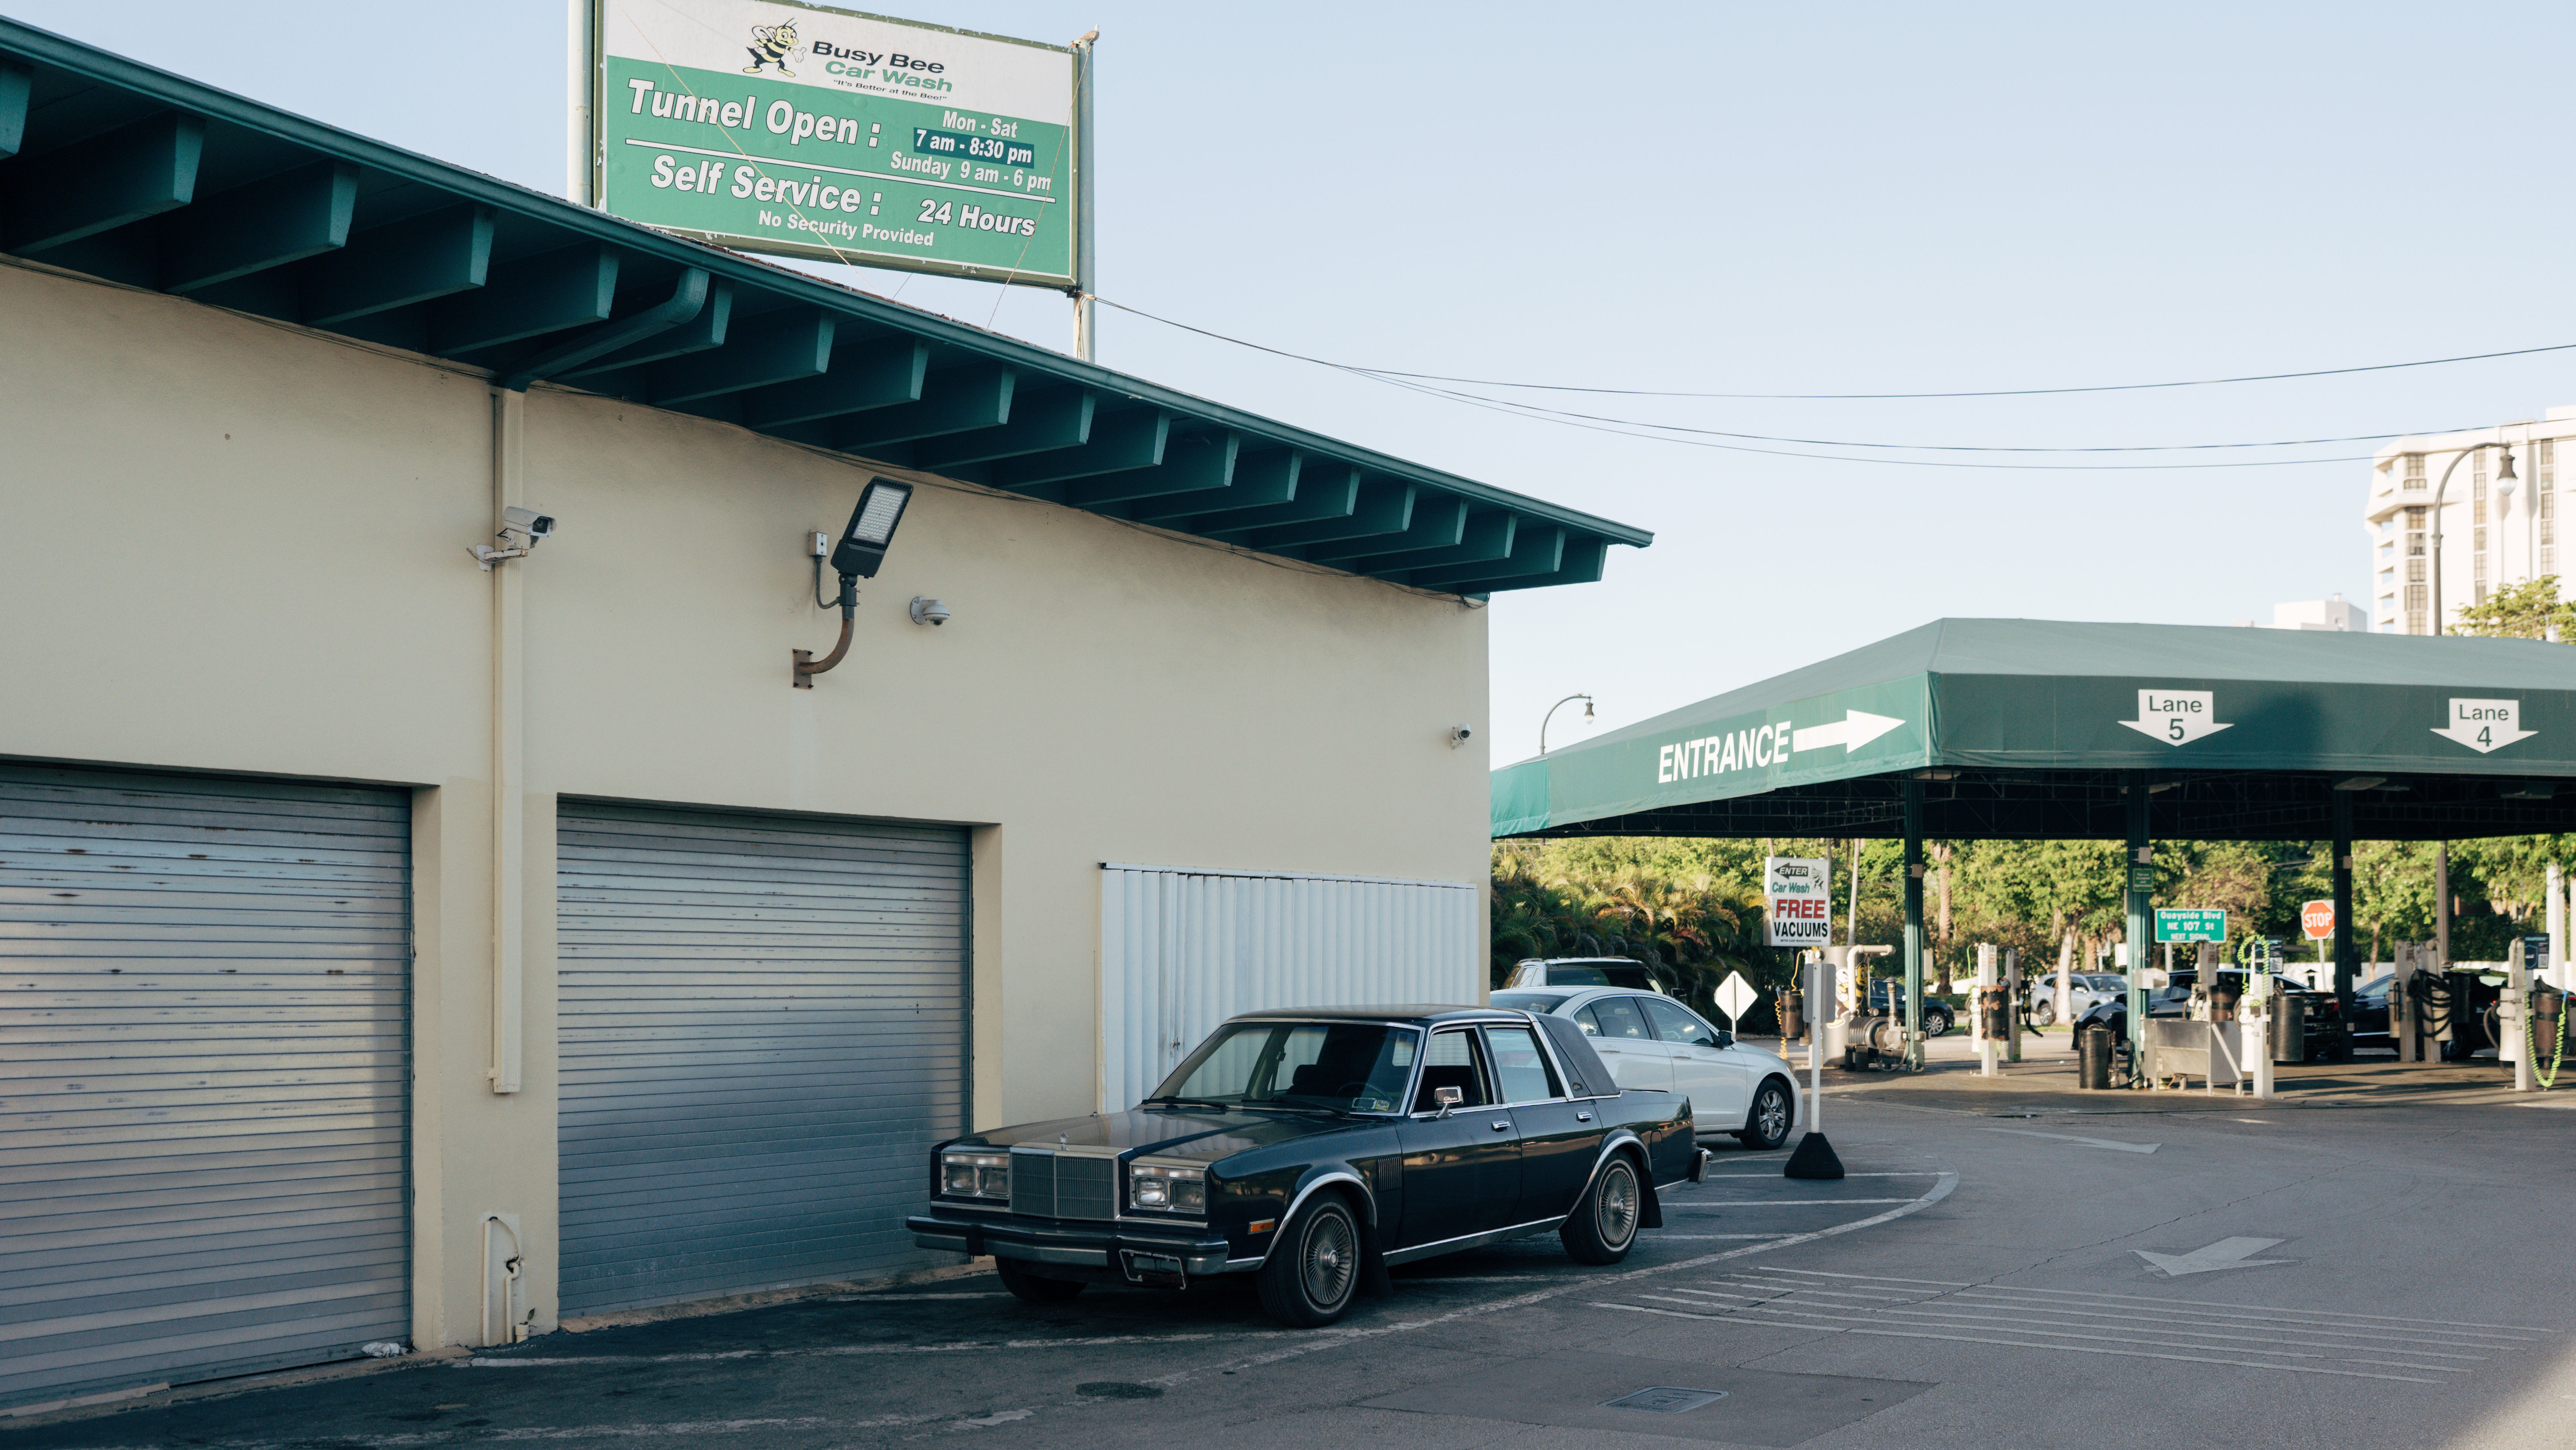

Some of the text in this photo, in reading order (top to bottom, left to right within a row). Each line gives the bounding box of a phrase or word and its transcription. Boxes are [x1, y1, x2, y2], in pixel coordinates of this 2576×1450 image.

[812, 41, 945, 74] Busy Bee
[826, 61, 953, 92] Car Wash
[856, 83, 886, 92] Better
[628, 78, 757, 130] Tunnel
[766, 99, 859, 146] Open
[942, 110, 976, 132] Mon
[990, 117, 1018, 139] Sat
[916, 129, 927, 147] 7
[929, 135, 955, 152] am
[969, 137, 1004, 159] 8:30
[1006, 147, 1032, 165] pm
[890, 151, 952, 180] Sunday
[959, 161, 970, 179] 9
[974, 167, 999, 183] am
[1013, 169, 1023, 187] 6
[1026, 174, 1051, 193] pm
[650, 154, 726, 195] Self
[730, 165, 861, 213] Service
[916, 198, 1036, 236] 24 Hours
[758, 209, 934, 247] No Security Provided
[2149, 695, 2203, 713] Lane
[2459, 704, 2509, 721] Lane
[2169, 718, 2185, 740] 5
[2477, 726, 2492, 747] 4
[1658, 720, 1791, 784] ENTRANCE
[1779, 867, 1807, 875] ENTER
[1772, 882, 1810, 893] Car Wash
[1776, 899, 1826, 918] FREE
[2160, 911, 2222, 921] Quayside Blvd
[1774, 922, 1828, 937] VACUUMS
[2167, 921, 2215, 931] NE 107 St
[2304, 912, 2333, 928] STOP
